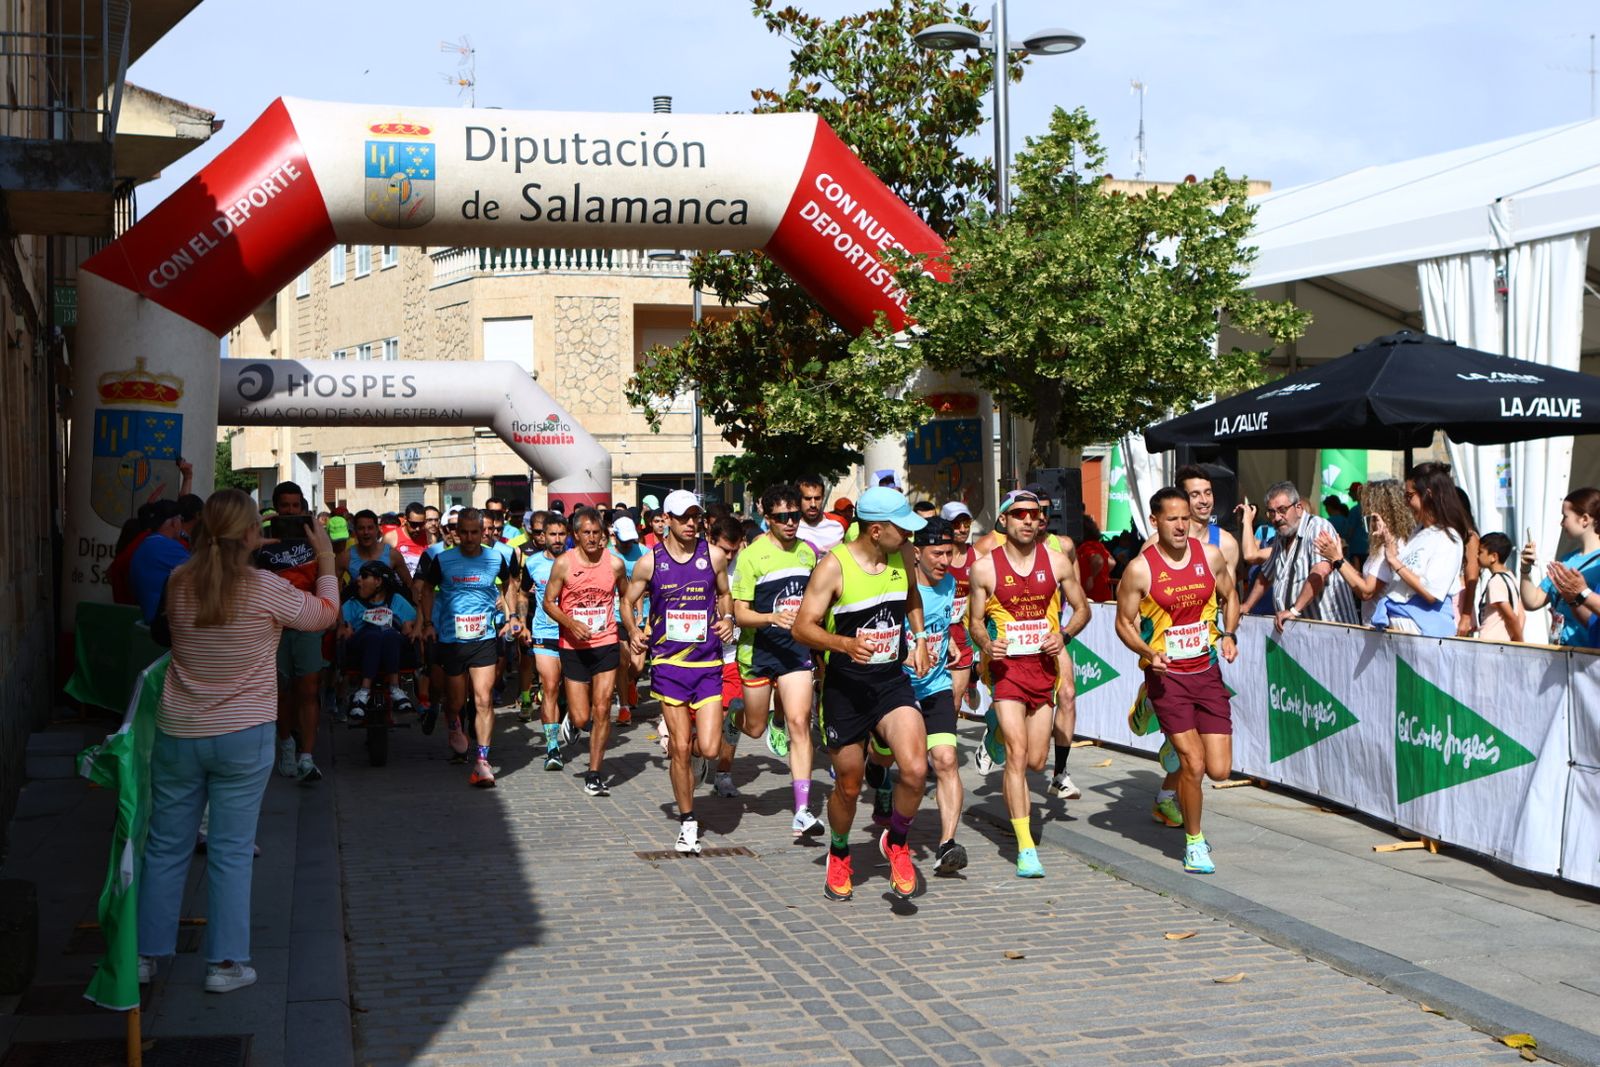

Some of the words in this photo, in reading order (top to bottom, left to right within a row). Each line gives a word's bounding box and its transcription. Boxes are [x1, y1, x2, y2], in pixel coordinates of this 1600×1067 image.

[464, 125, 706, 174] Diputación
[814, 173, 858, 216] CON
[461, 189, 500, 221] de
[519, 182, 749, 226] Salamanca
[148, 248, 195, 289] CON
[188, 231, 220, 257] EL
[211, 160, 302, 238] DEPORTE
[287, 373, 418, 399] HOSPES
[239, 407, 319, 420] PALACIO
[325, 407, 347, 420] DE
[351, 407, 388, 421] SAN
[392, 407, 464, 421] ESTEBAN
[1500, 397, 1524, 417] LA
[1526, 397, 1582, 418] SALVE
[1214, 417, 1230, 437] LA
[1231, 411, 1269, 434] SALVE
[513, 432, 575, 445] bedunia
[1176, 592, 1197, 603] VINO
[587, 618, 594, 626] 8
[667, 612, 707, 621] bedunia
[464, 624, 481, 632] 182
[683, 623, 691, 633] 9
[1006, 621, 1049, 632] bedunia
[1017, 633, 1040, 646] 128
[1177, 636, 1201, 650] 148
[1269, 683, 1281, 710] El
[1281, 686, 1301, 717] Corte
[1302, 684, 1337, 731] Inglés
[1398, 710, 1410, 743] El
[1409, 715, 1443, 752] Corte
[1443, 714, 1501, 770] Inglés
